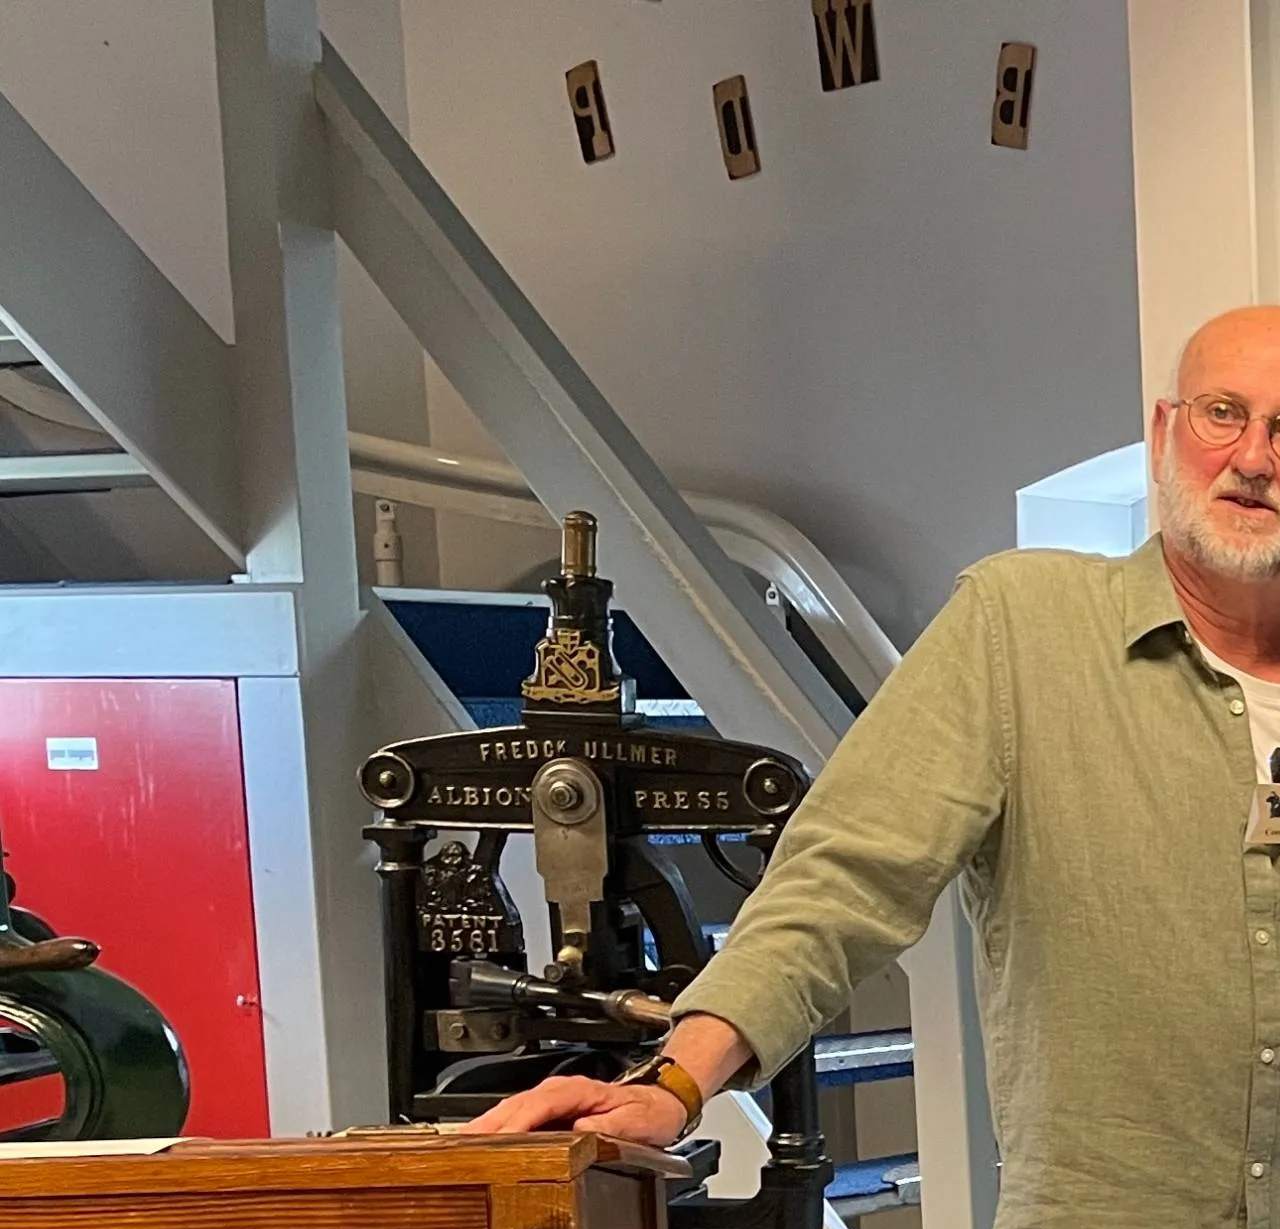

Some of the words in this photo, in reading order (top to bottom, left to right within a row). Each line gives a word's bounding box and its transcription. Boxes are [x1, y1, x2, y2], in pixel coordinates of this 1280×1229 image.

[584, 741, 677, 766] ULLMER
[427, 786, 533, 807] ALBION
[634, 789, 730, 811] PRESS
[422, 914, 503, 929] PATENT
[431, 928, 499, 952] 3581
